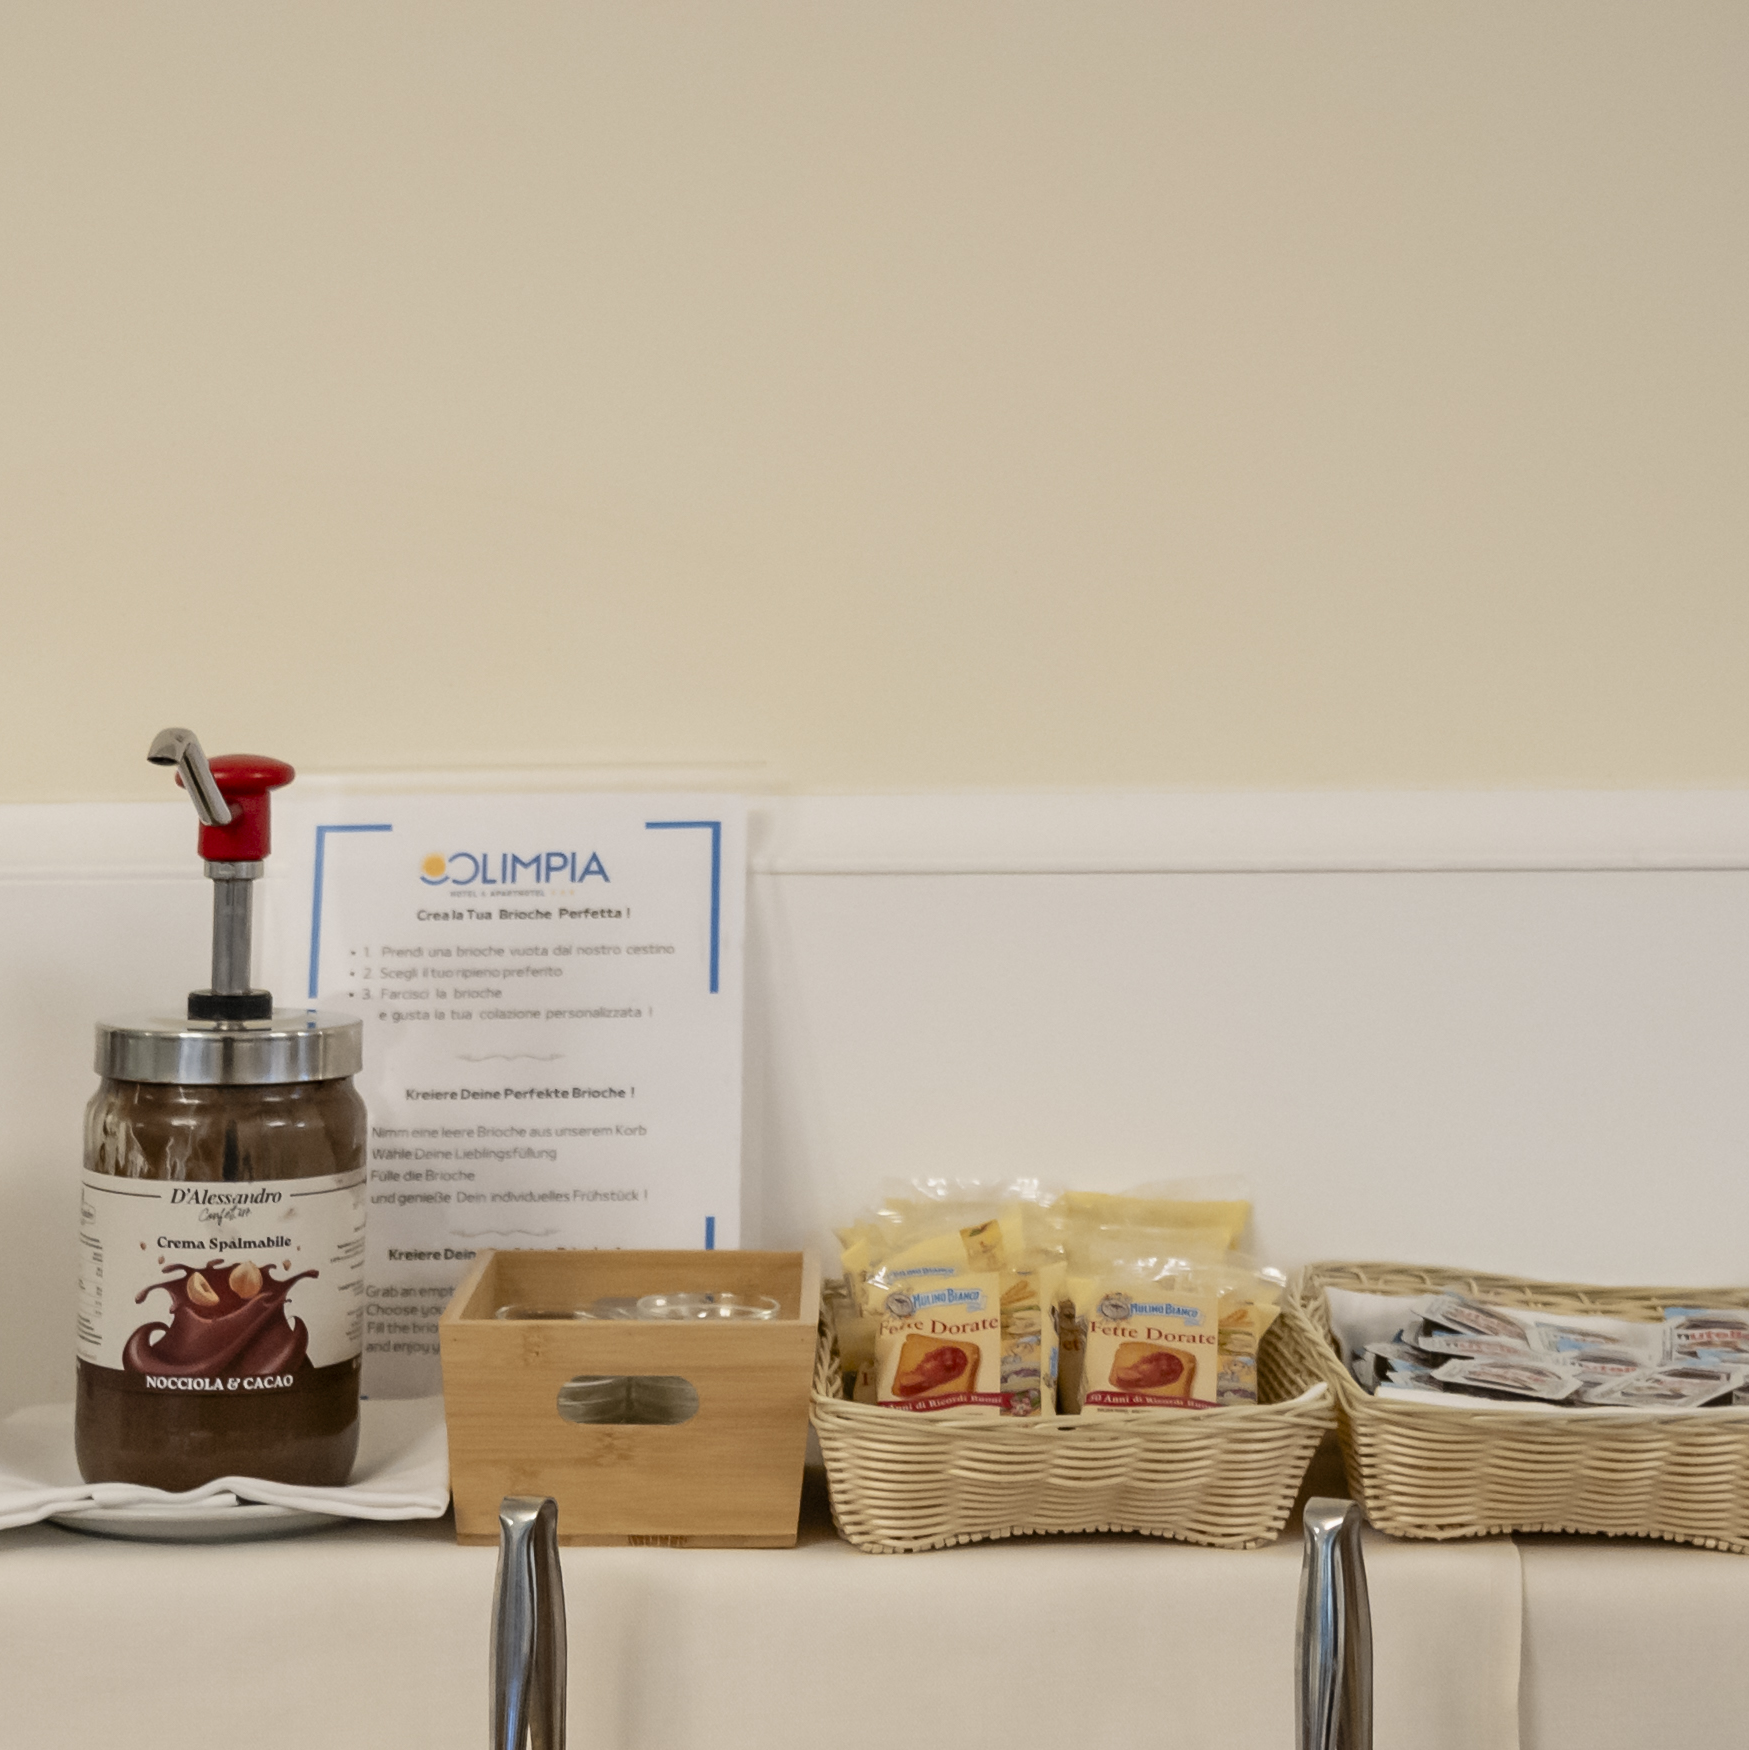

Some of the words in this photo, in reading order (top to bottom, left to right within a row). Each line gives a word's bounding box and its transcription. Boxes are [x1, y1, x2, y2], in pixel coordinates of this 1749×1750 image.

[447, 850, 611, 885] OLIMPIA
[417, 909, 449, 921] Crea
[452, 909, 464, 921] la
[467, 908, 492, 921] Tua
[499, 908, 553, 920] Brioche
[558, 907, 623, 920] Perfetta
[381, 946, 424, 958] Prendi
[428, 948, 452, 958] una
[456, 945, 505, 957] brioche
[509, 946, 549, 957] vuota
[576, 945, 622, 956] nostro
[625, 944, 676, 955] cestino
[380, 967, 418, 982] Scegli
[456, 967, 500, 982] ripieno
[502, 966, 564, 981] preferito
[381, 987, 430, 1000] Farcisci
[454, 987, 502, 999] brioche
[391, 1009, 430, 1024] gusta
[450, 1008, 473, 1020] tua
[479, 1007, 542, 1020] colazione
[545, 1006, 643, 1022] personalizzata
[405, 1088, 458, 1101] Kreiere
[460, 1088, 501, 1100] Deine
[503, 1087, 570, 1100] Perfekte
[571, 1087, 626, 1099] Brioche
[372, 1127, 410, 1139] Nimm
[411, 1127, 440, 1138] eine
[441, 1126, 475, 1138] leere
[477, 1126, 527, 1138] Brioche
[529, 1128, 553, 1137] aus
[555, 1127, 613, 1137] unserem
[615, 1125, 648, 1136] Korb
[414, 1148, 453, 1160] Deine
[402, 1169, 423, 1182] die
[425, 1169, 475, 1182] Brioche
[170, 1187, 283, 1205] D'Alessandro
[370, 1192, 397, 1205] und
[456, 1191, 487, 1204] Dein
[490, 1190, 570, 1203] individuelles
[157, 1236, 206, 1250] Crema
[209, 1235, 292, 1252] Spalmabile
[388, 1249, 441, 1261] Kreiere
[443, 1248, 477, 1260] Dein
[365, 1285, 401, 1298] Grab
[419, 1286, 456, 1300] empt
[366, 1304, 418, 1317] Choose
[387, 1321, 410, 1334] the
[412, 1321, 438, 1334] brio
[931, 1317, 999, 1336] Dorate
[1089, 1320, 1139, 1340] Fette
[1146, 1326, 1217, 1346] Dorate
[146, 1374, 224, 1391] NOCCIOLA
[226, 1376, 241, 1391] &
[243, 1373, 294, 1390] CACAO
